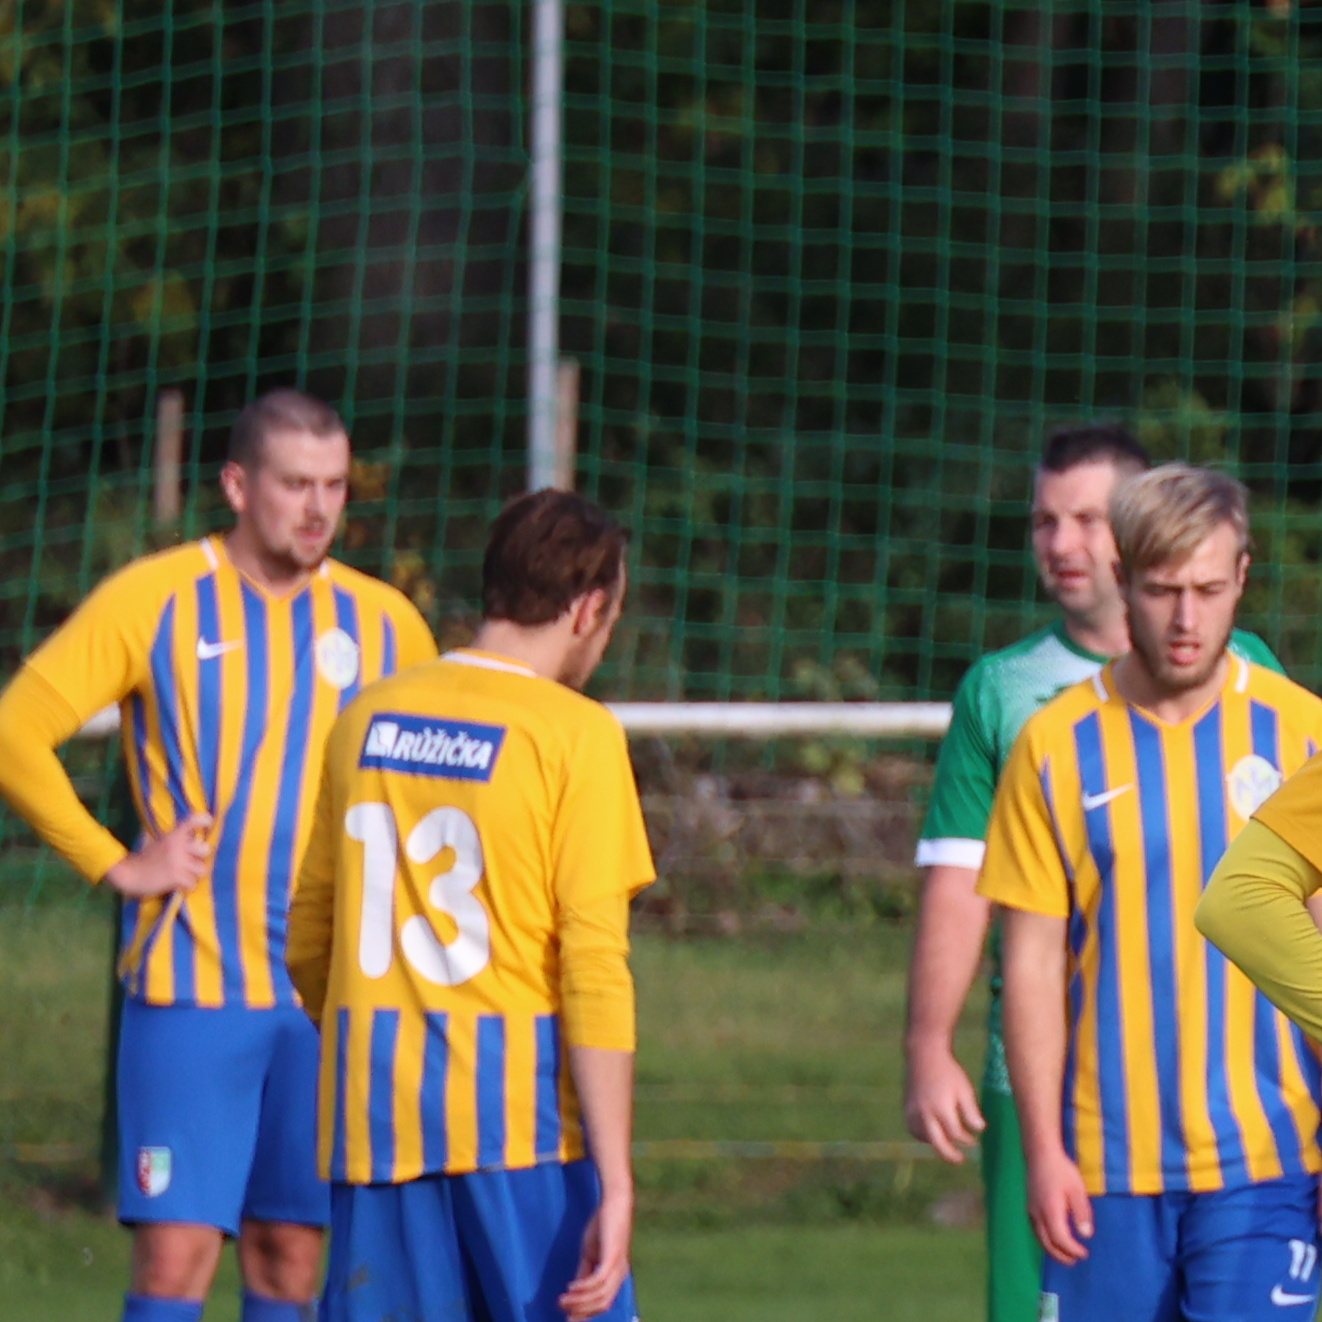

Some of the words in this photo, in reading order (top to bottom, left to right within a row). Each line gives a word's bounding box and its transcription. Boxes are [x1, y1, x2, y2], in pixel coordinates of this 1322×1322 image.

[392, 726, 493, 770] RŮŽIČKA
[344, 801, 491, 986] 13
[1287, 1239, 1318, 1283] 11
